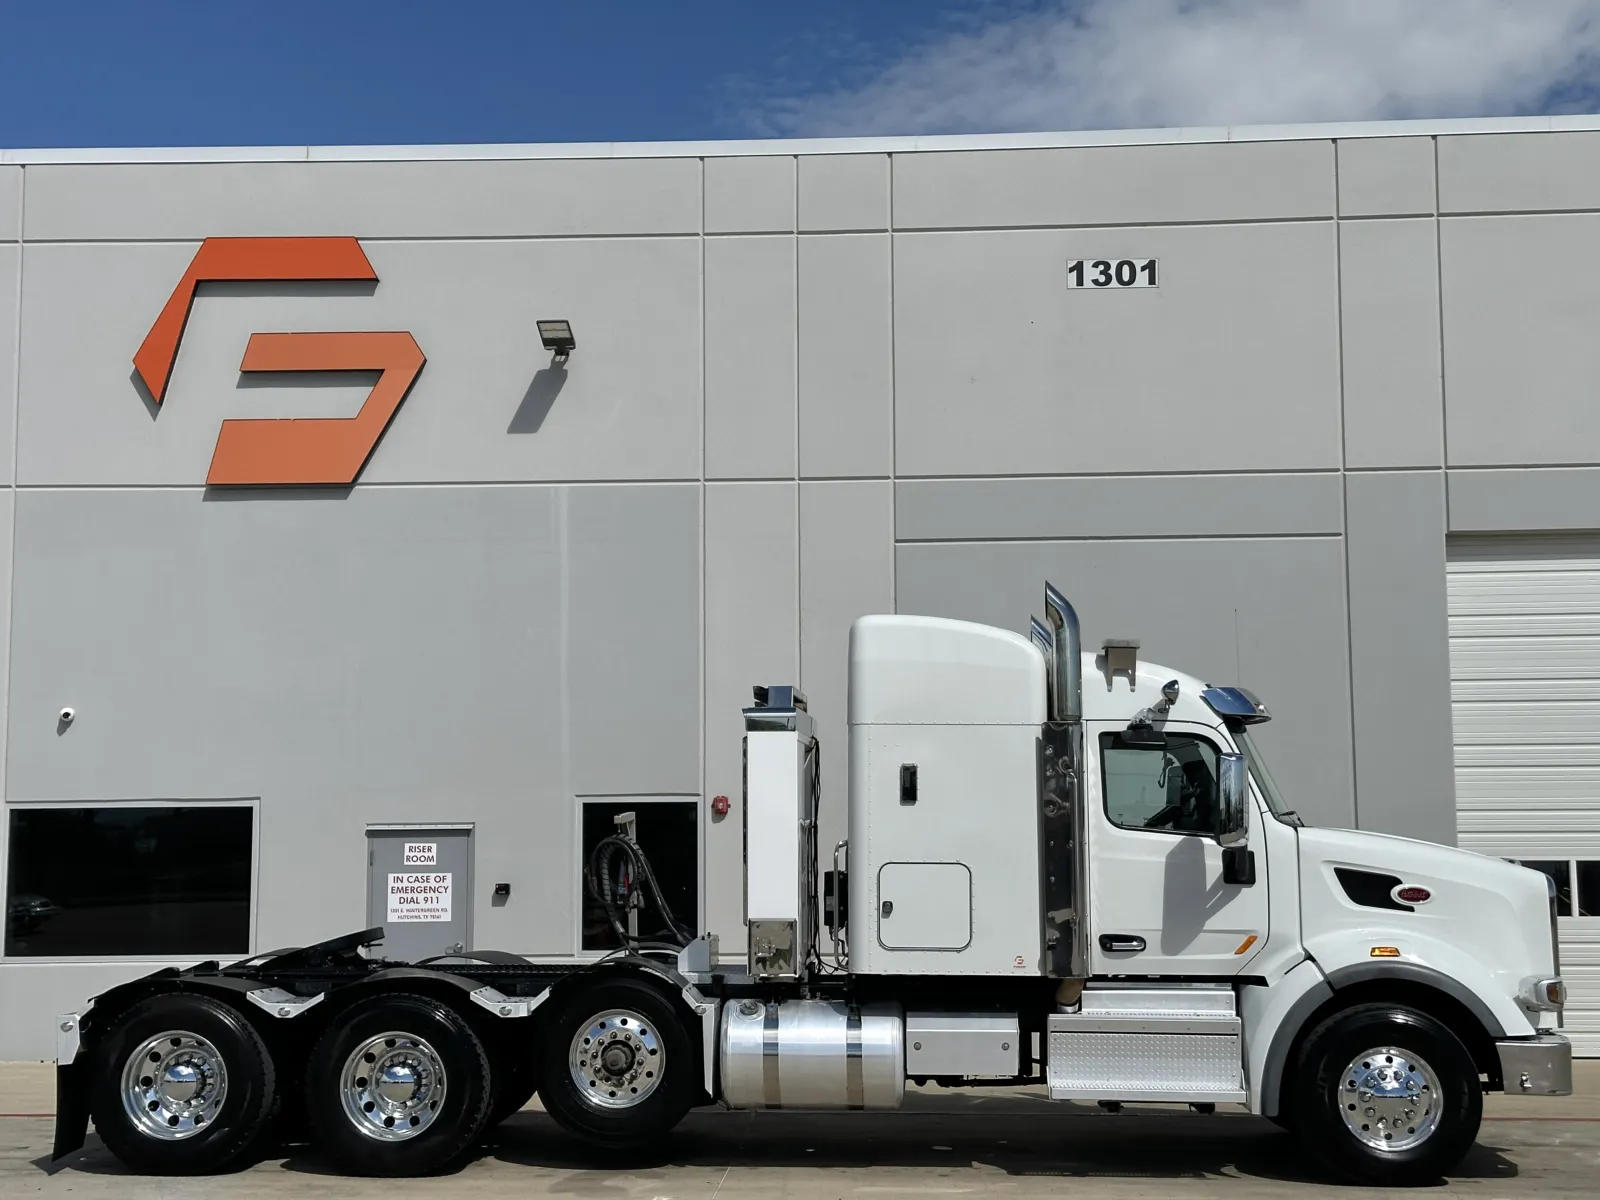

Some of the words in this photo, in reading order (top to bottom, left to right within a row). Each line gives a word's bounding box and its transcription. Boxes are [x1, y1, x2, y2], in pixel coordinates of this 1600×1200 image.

[1069, 260, 1156, 287] 1301
[408, 845, 433, 853] RISER
[405, 855, 435, 863] ROOM
[393, 876, 404, 884] IN
[407, 875, 431, 883] CASE
[434, 875, 448, 883] OF
[390, 886, 449, 894] EMERGENCY
[398, 896, 420, 904] DIAL
[423, 896, 439, 904] 911
